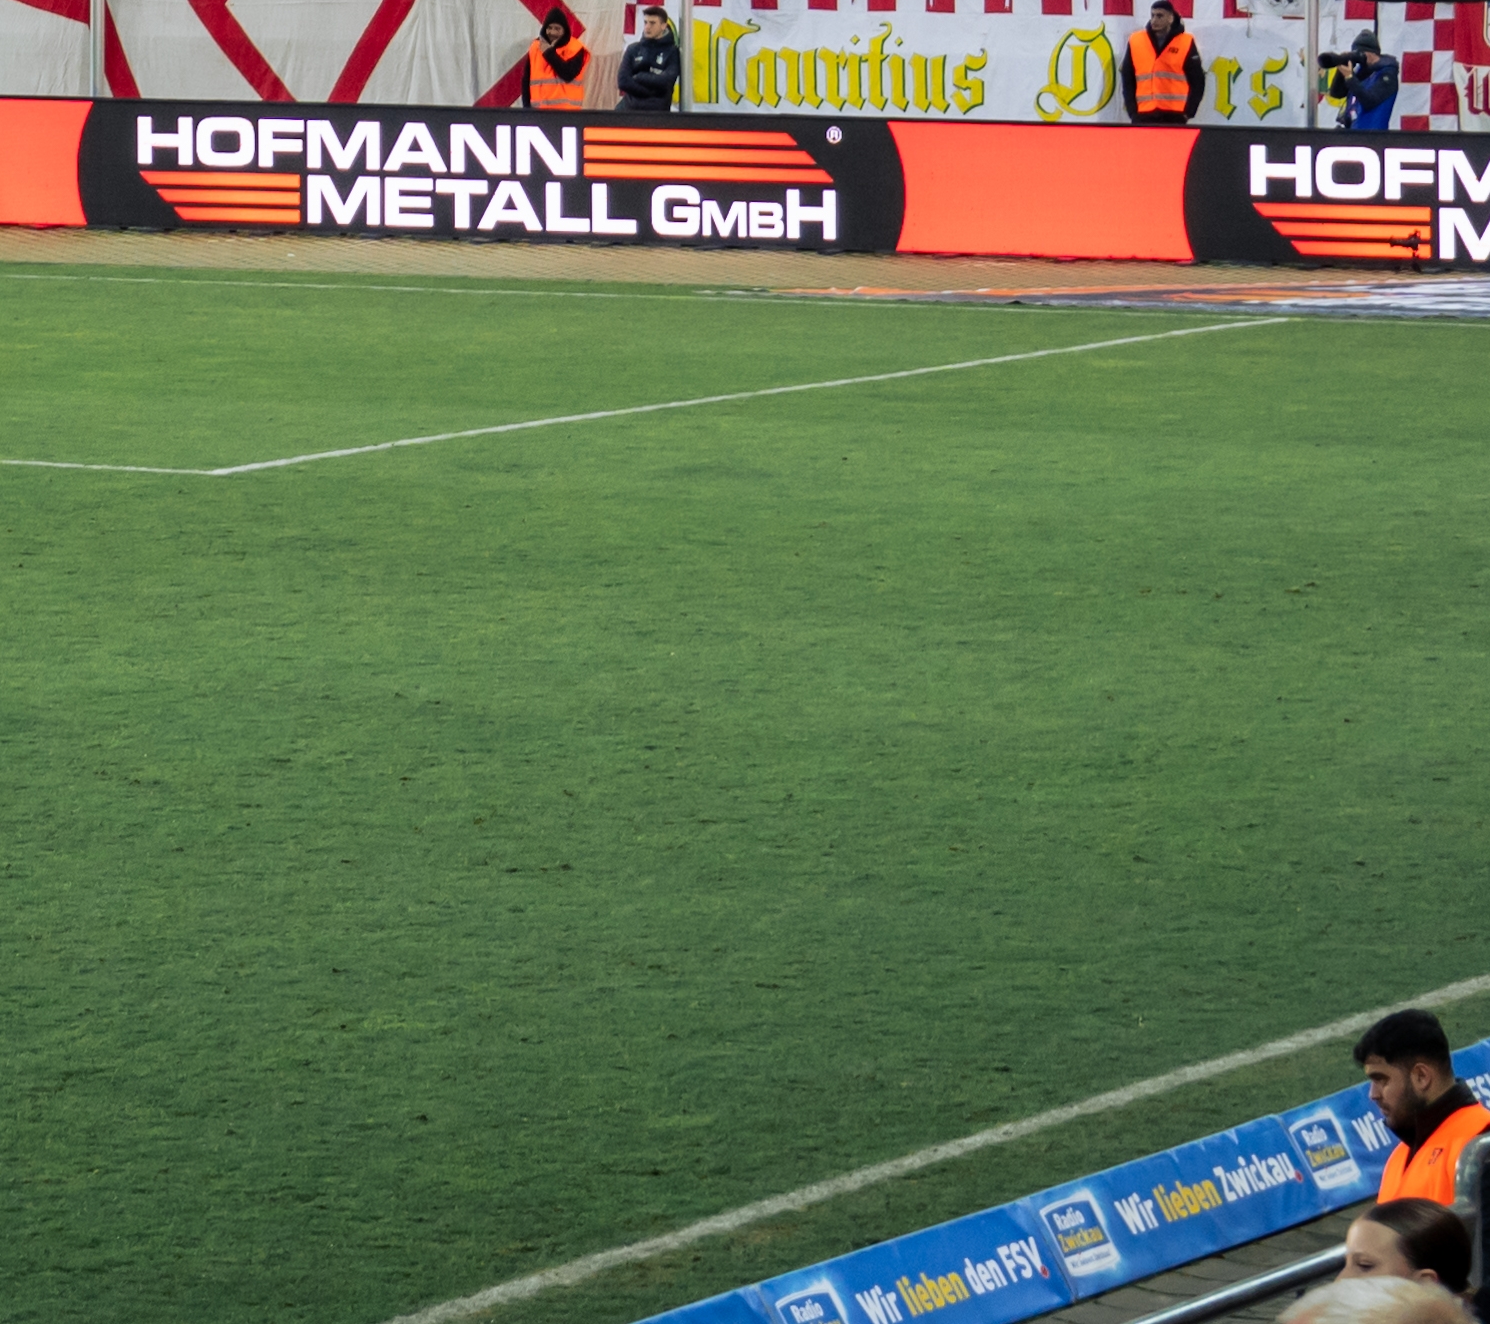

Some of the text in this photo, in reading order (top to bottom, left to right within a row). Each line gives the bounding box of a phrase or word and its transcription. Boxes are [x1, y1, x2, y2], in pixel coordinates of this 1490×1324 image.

[137, 114, 577, 179] HOFMANN
[306, 174, 637, 239] METALL
[1052, 1205, 1084, 1230] Radio
[1115, 1191, 1159, 1235] Wir
[1152, 1178, 1223, 1223] lieben
[1058, 1225, 1105, 1252] Zwickau
[856, 1284, 903, 1324] Wir
[896, 1271, 971, 1317] lieben
[964, 1255, 1006, 1297] den
